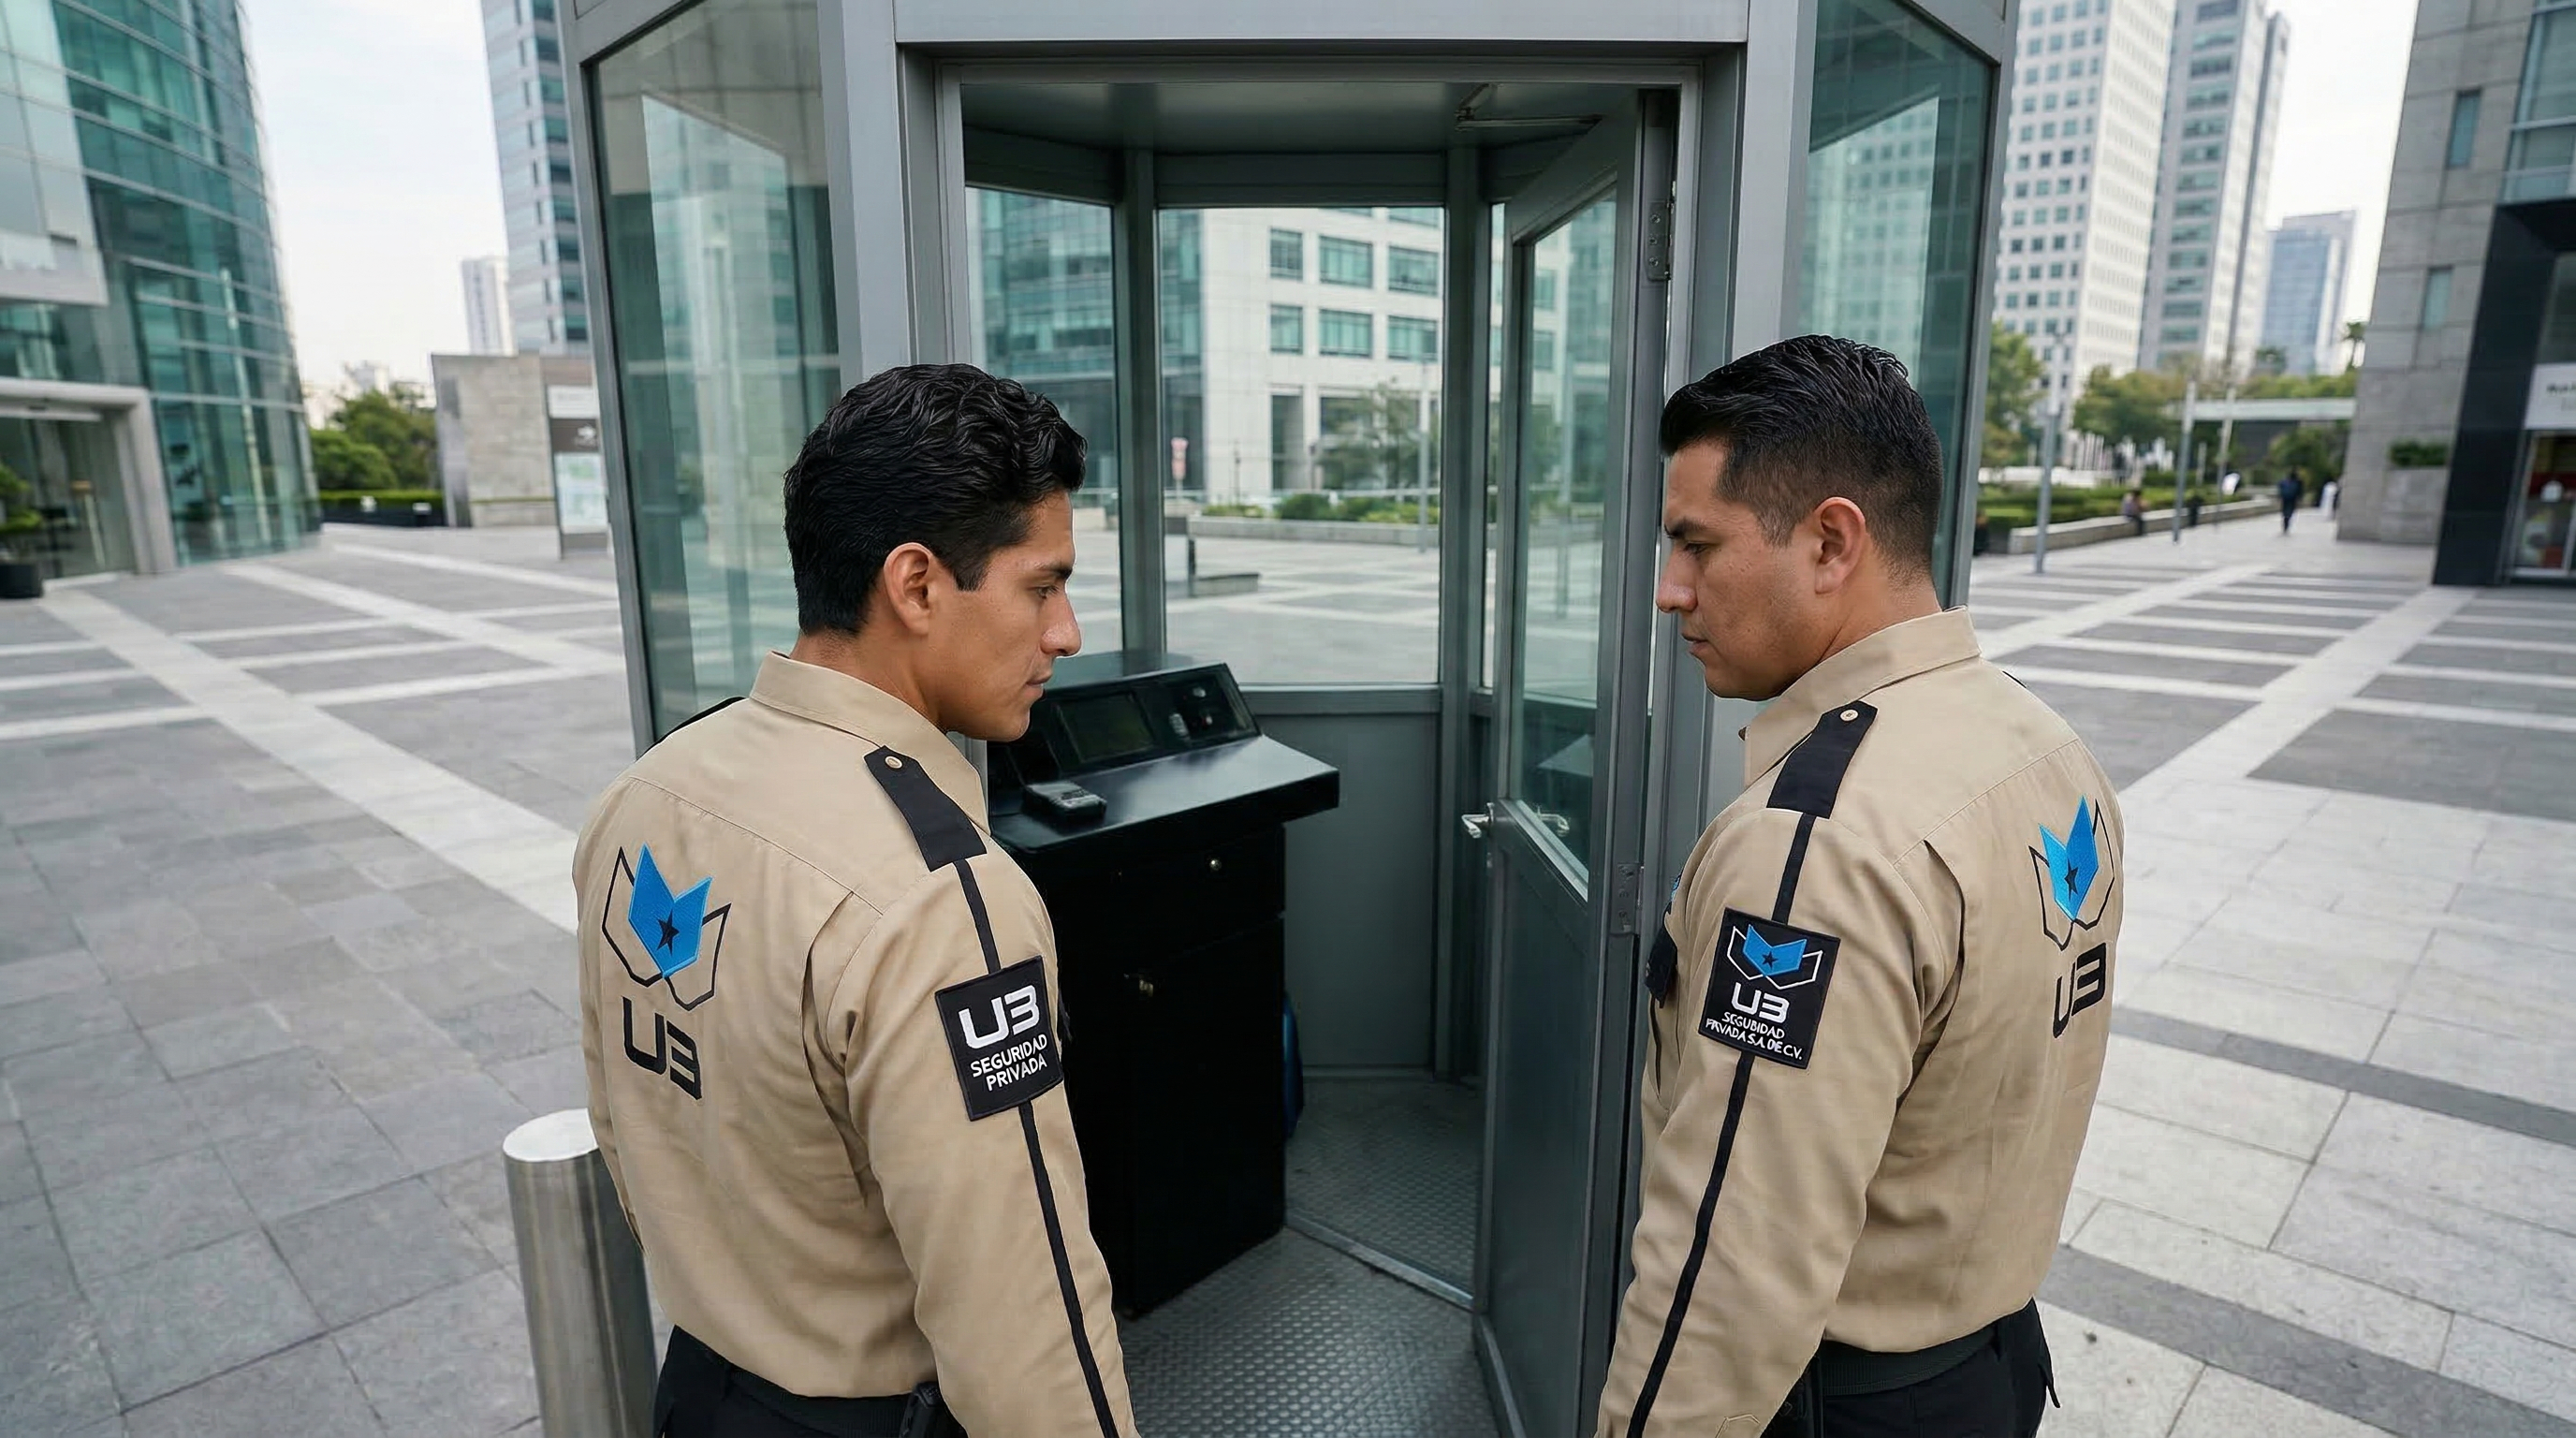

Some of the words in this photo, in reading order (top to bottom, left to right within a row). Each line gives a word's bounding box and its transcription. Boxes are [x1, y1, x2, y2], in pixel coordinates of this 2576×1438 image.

[958, 984, 1041, 1049] U3
[1731, 981, 1790, 1024] U3
[970, 1034, 1047, 1078] SEGURIDAD
[986, 1052, 1047, 1092] PRIVADA
